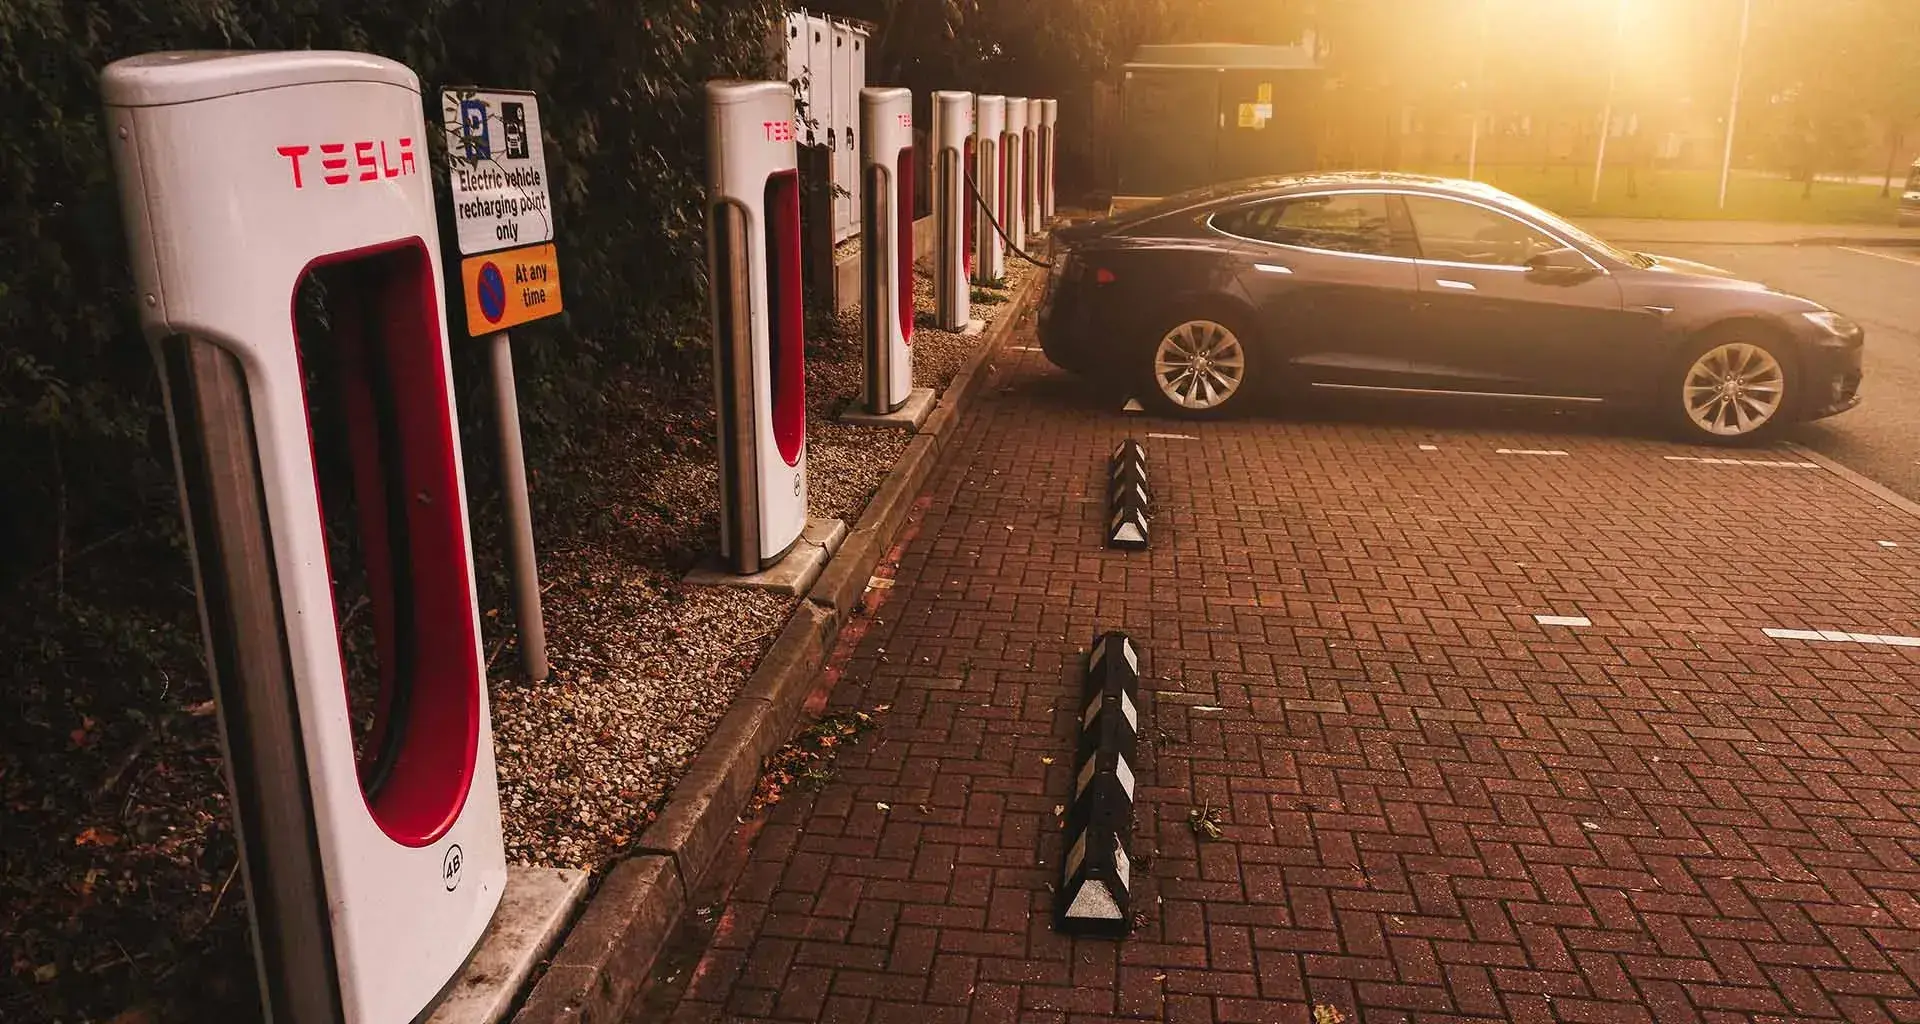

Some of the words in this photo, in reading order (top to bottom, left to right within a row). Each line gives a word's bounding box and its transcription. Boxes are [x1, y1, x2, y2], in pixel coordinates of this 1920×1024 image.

[276, 137, 416, 189] TESLA
[460, 168, 503, 192] Electric
[505, 166, 541, 188] vehicle
[459, 194, 518, 220] recharging
[520, 191, 546, 216] point
[496, 218, 518, 242] only
[515, 263, 528, 285] At
[530, 263, 547, 282] any
[522, 287, 546, 308] time
[446, 854, 460, 879] 4B
